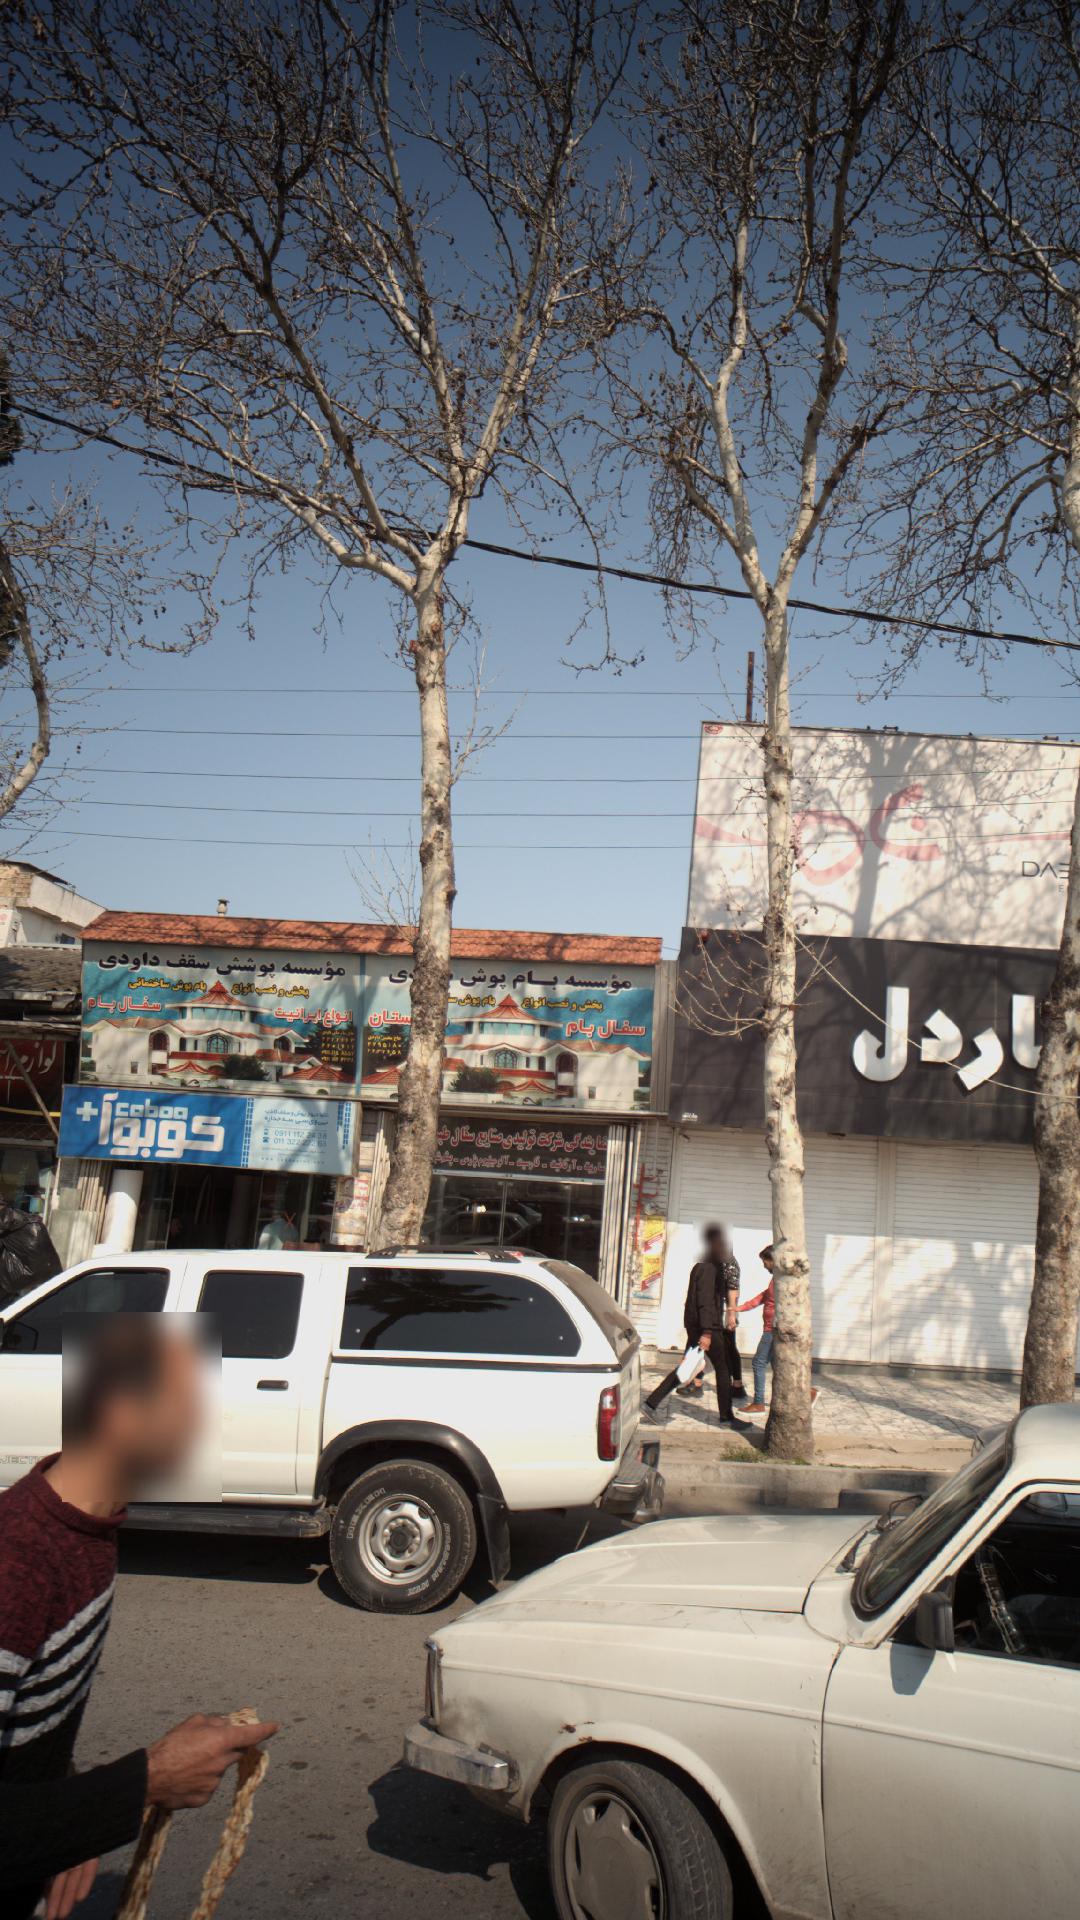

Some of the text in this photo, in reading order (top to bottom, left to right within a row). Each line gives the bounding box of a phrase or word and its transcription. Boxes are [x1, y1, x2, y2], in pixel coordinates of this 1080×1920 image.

[99, 952, 346, 981] مؤسسه پوشش سقف داودی
[460, 968, 507, 989] پوش
[513, 970, 558, 990] بام
[565, 974, 632, 994] مؤسسه
[117, 995, 162, 1014] سفال
[274, 1006, 322, 1024] ایرانیت
[597, 1019, 646, 1039] سفال
[852, 986, 1042, 1090] اردل
